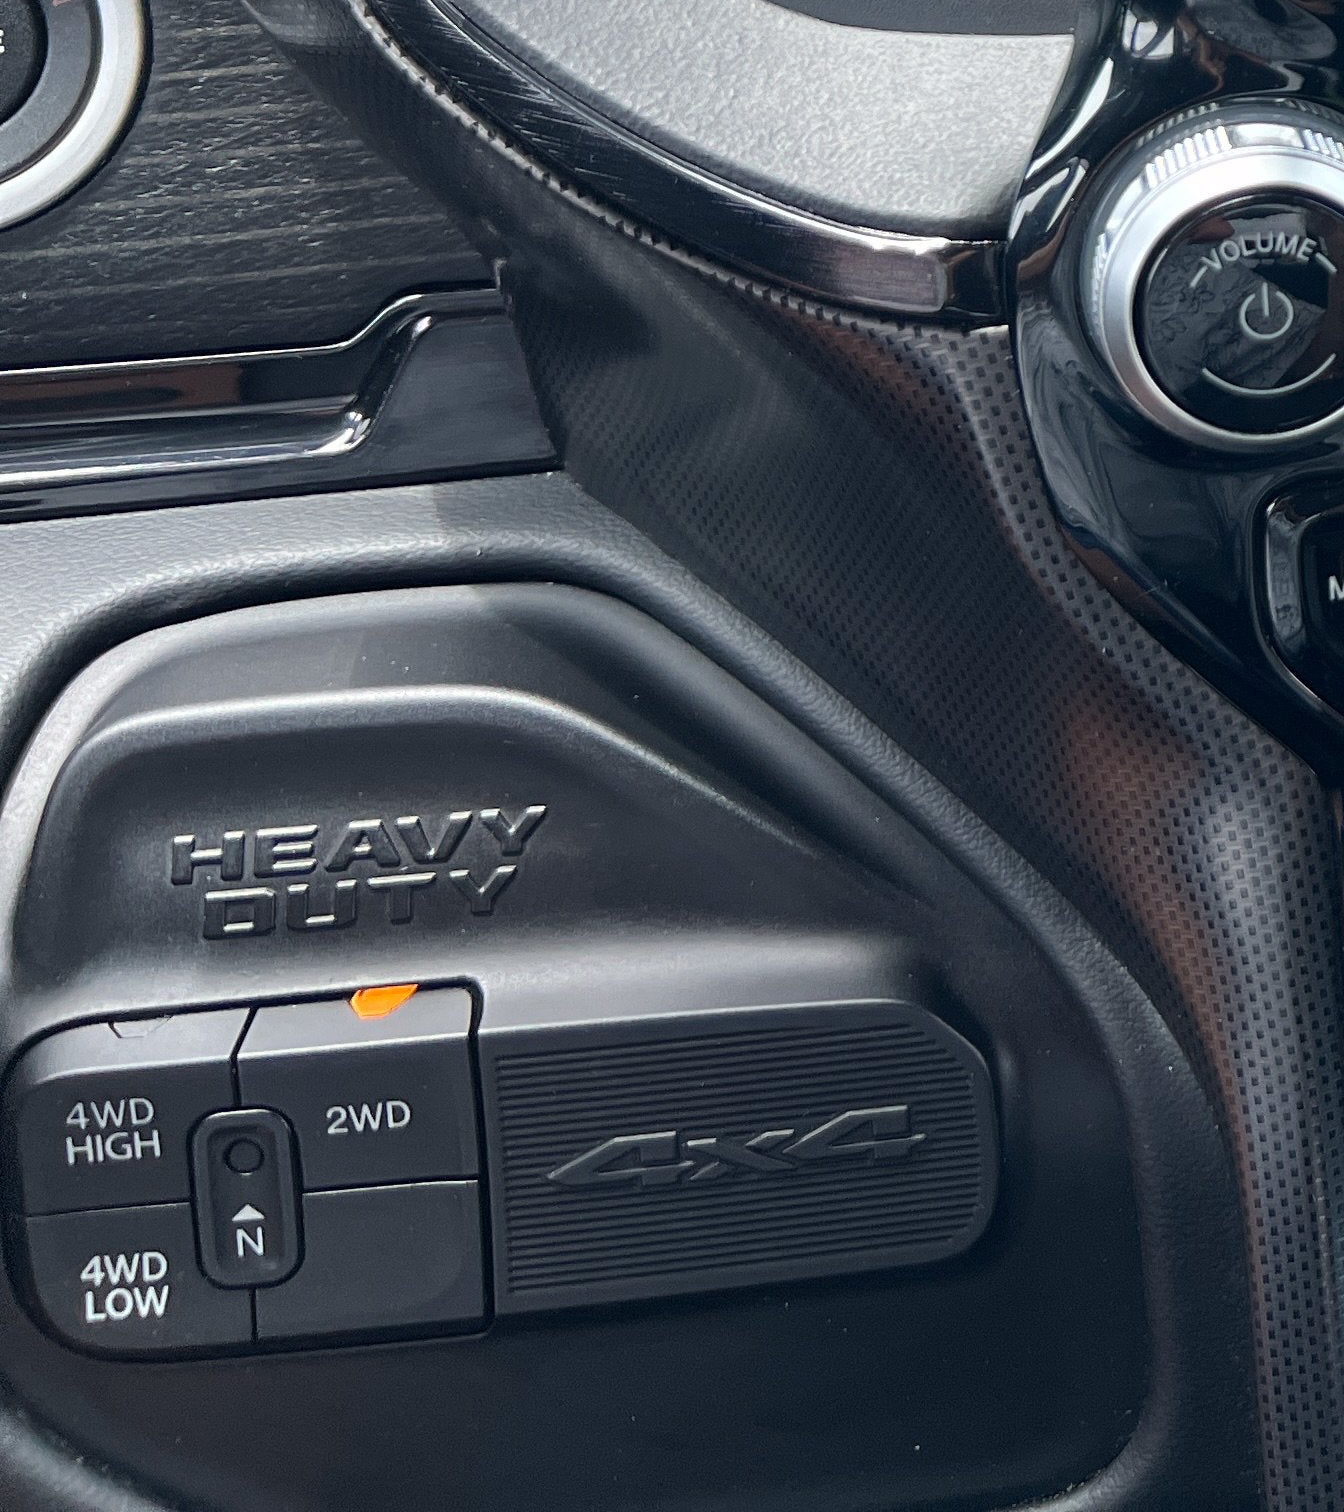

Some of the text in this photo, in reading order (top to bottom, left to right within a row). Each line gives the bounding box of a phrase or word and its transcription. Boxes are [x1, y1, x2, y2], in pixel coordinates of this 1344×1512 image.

[1200, 231, 1318, 271] VOLUME
[170, 805, 547, 885] HEAVY
[201, 863, 519, 941] DUTY
[64, 1097, 155, 1130] 4WD
[326, 1102, 411, 1135] 2WD
[65, 1129, 162, 1164] HIGH
[235, 1226, 266, 1257] N
[80, 1251, 168, 1284] 4WD
[84, 1283, 170, 1320] LOW
